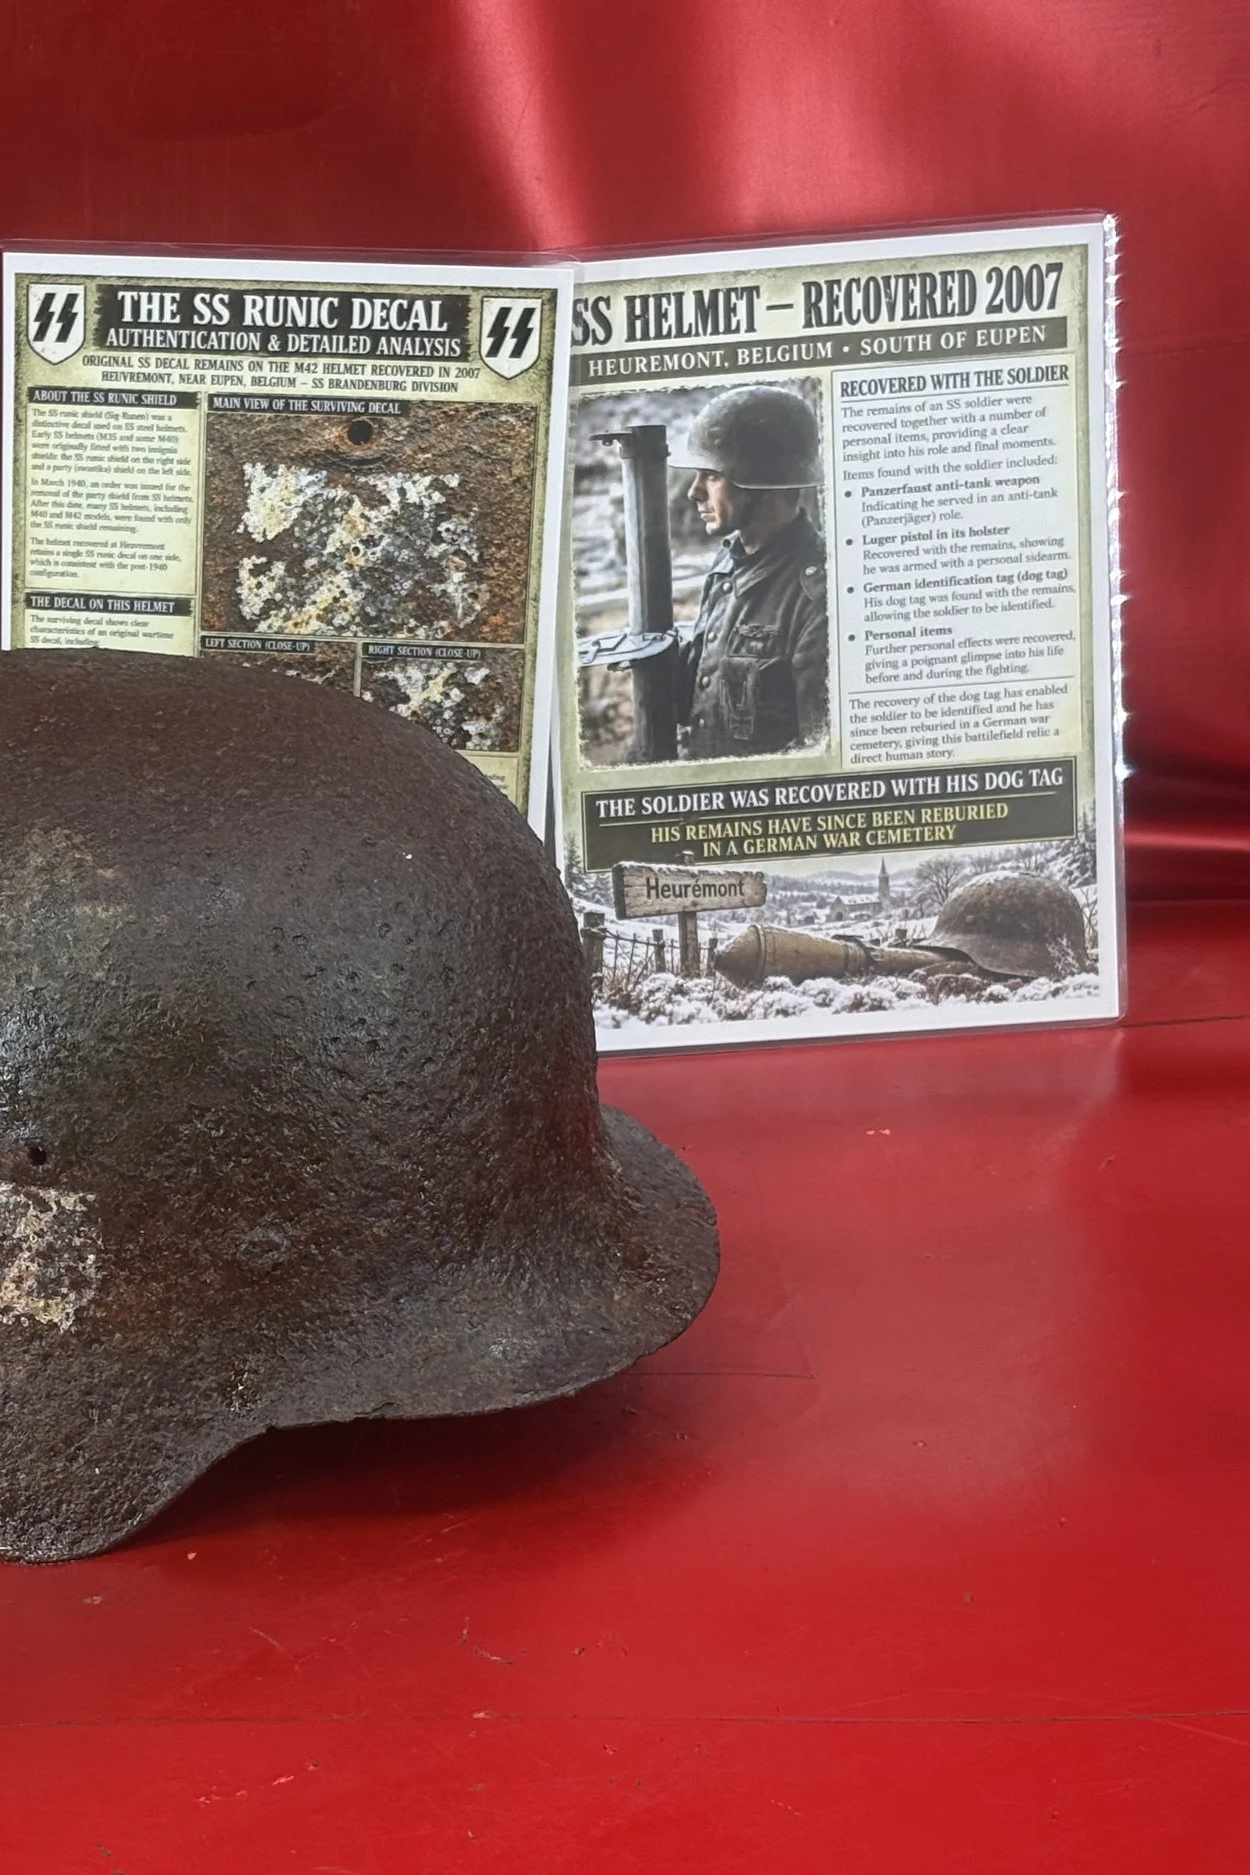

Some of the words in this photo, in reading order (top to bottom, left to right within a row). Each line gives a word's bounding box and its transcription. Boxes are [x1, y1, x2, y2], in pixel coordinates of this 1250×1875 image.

[118, 292, 180, 324] THE
[193, 294, 229, 326] SS
[243, 295, 338, 328] RUNIC
[352, 298, 447, 331] DECAL
[571, 295, 612, 346] SS
[626, 284, 759, 343] HELMET
[803, 269, 976, 330] RECOVERED
[986, 263, 1063, 316] 2007
[106, 330, 260, 352] AUTHENTICATION
[268, 333, 279, 352] &
[287, 334, 370, 355] DETAILED
[377, 336, 460, 357] ANALYSIS
[589, 349, 728, 378] HEUREMONT,
[737, 341, 832, 367] BELGIUM
[860, 334, 931, 357] SOUTH
[940, 331, 966, 351] OF
[976, 325, 1045, 348] EUPEN
[81, 356, 133, 369] ORIGINAL
[138, 358, 150, 369] SS
[154, 358, 188, 371] DECAL
[194, 359, 243, 372] REMAINS
[248, 361, 262, 373] ON
[268, 361, 289, 373] THE
[294, 362, 317, 374] M42
[322, 363, 365, 376] HELMET
[370, 364, 434, 378] RECOVERED
[438, 366, 450, 378] IN
[455, 366, 480, 379] 2007
[101, 373, 173, 386] HEUVREMONT,
[178, 375, 206, 386] NEAR
[210, 375, 245, 387] EUPEN,
[250, 376, 296, 389] BELGIUM
[312, 378, 323, 389] SS
[328, 378, 406, 391] BRANDENBURG
[411, 380, 457, 392] DIVISION
[840, 375, 926, 398] RECOVERED
[930, 371, 969, 391] WITH
[976, 369, 1002, 388] THE
[1007, 364, 1069, 385] SOLDIER
[33, 391, 66, 402] ABOUT
[71, 392, 89, 403] THE
[93, 393, 104, 403] SS
[108, 393, 137, 404] RUNIC
[141, 394, 176, 405] SHIELD
[213, 397, 240, 409] MAIN
[244, 398, 268, 410] VIEW
[272, 399, 284, 410] OF
[289, 399, 307, 411] THE
[311, 400, 364, 413] SURVIVING
[368, 402, 401, 414] DECAL
[861, 481, 932, 498] Panzerfaust
[934, 477, 992, 493] anti-tank
[994, 475, 1040, 488] weapon
[862, 532, 897, 547] Luger
[900, 530, 932, 544] pistol
[936, 529, 948, 542] in
[951, 528, 966, 540] its
[968, 524, 1010, 539] holster
[31, 597, 50, 608] THE
[54, 597, 85, 609] DECAL
[89, 599, 103, 610] ON
[108, 599, 130, 611] THIS
[134, 600, 174, 613] HELMET
[864, 626, 916, 642] Personal
[920, 624, 953, 638] items
[205, 638, 224, 649] LEFT
[227, 639, 261, 650] SECTION
[264, 640, 310, 652] (CLOSE-UP)
[368, 645, 394, 657] RIGHT
[397, 646, 432, 658] SECTION
[435, 648, 480, 660] (CLOSE-UP)
[596, 796, 634, 819] THE
[642, 791, 724, 816] SOLDIER
[730, 788, 768, 810] WAS
[775, 780, 885, 807] RECOVERED
[891, 776, 940, 799] WITH
[946, 774, 978, 795] HIS
[984, 771, 1023, 792] DOG
[1029, 768, 1063, 789] TAG
[651, 823, 680, 844] HIS
[686, 818, 762, 842] REMAINS
[768, 815, 811, 836] HAVE
[817, 811, 866, 833] SINCE
[872, 808, 915, 829] BEEN
[921, 802, 1008, 826] REBURIED
[703, 838, 721, 858] IN
[726, 837, 738, 856] A
[743, 832, 817, 855] GERMAN
[823, 830, 860, 850] WAR
[866, 824, 956, 848] CEMETERY
[646, 877, 745, 899] Heurémont
